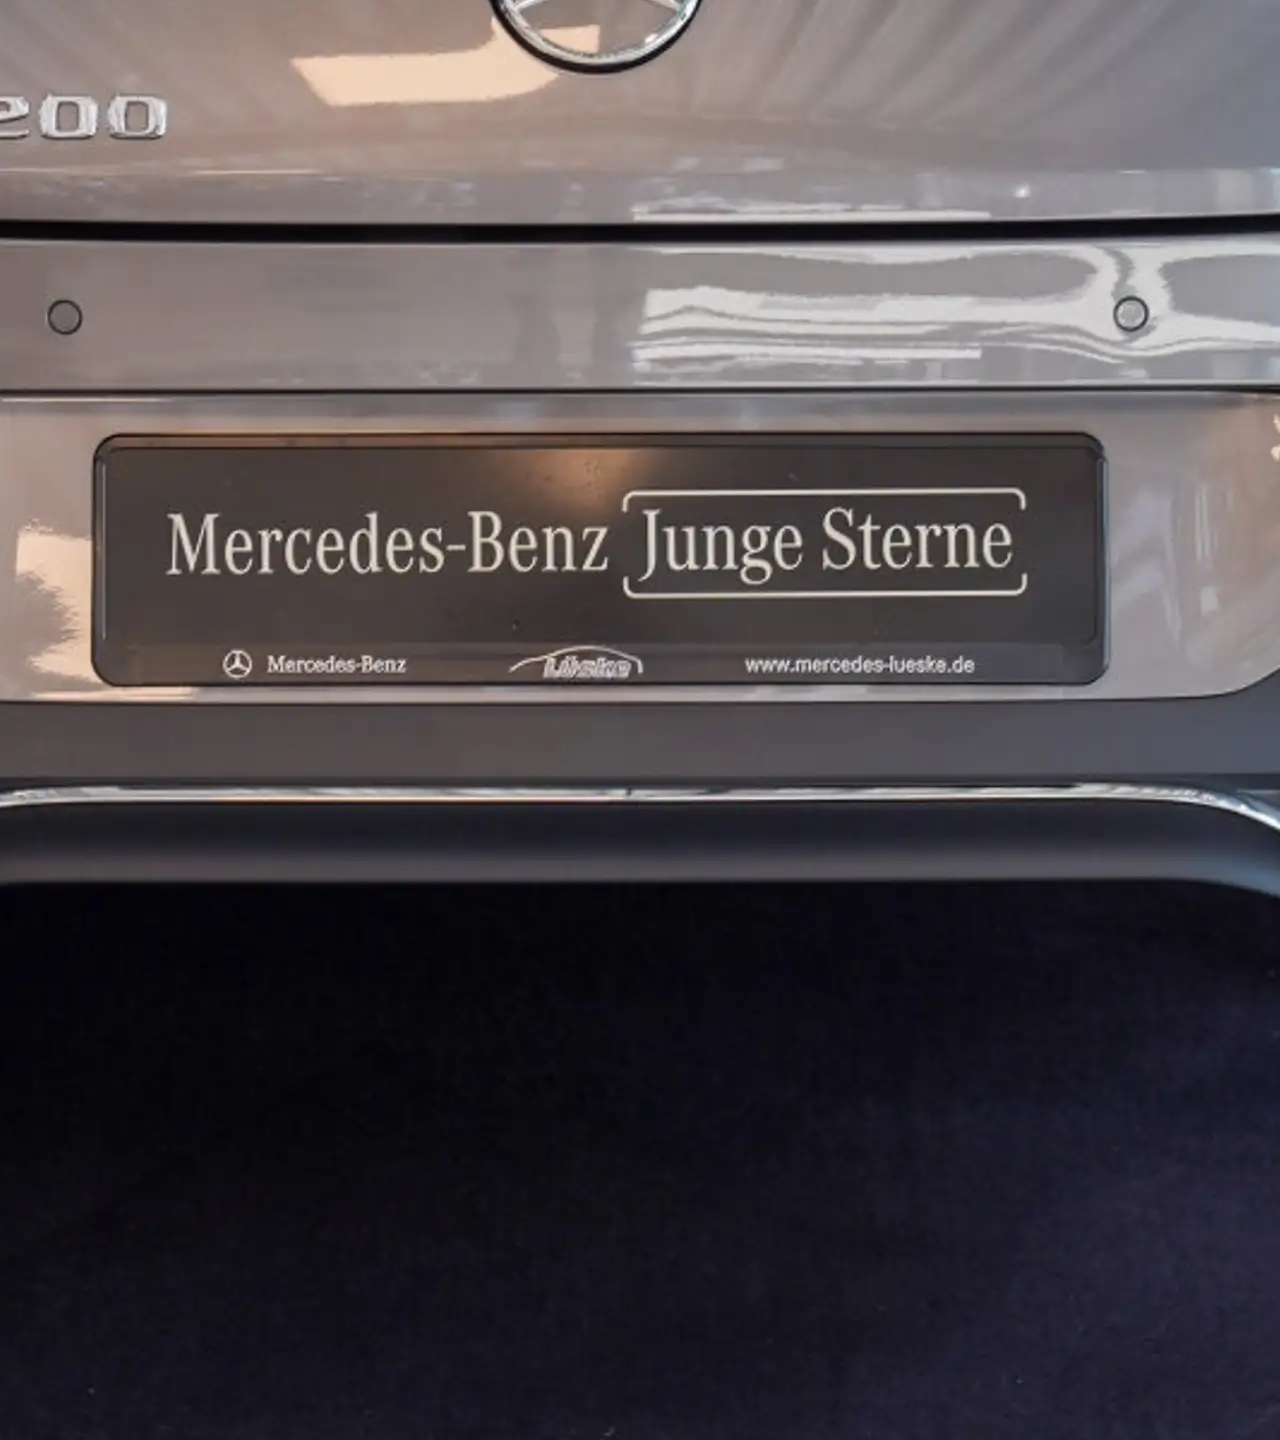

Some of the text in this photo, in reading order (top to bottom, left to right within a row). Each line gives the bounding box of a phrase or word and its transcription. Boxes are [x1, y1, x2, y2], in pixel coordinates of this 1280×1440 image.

[166, 506, 1014, 586] Mercedes-Benz Junge Sterne
[266, 655, 408, 674] Mercedes-Benz
[744, 654, 976, 674] www.mercedes-lueske.de
